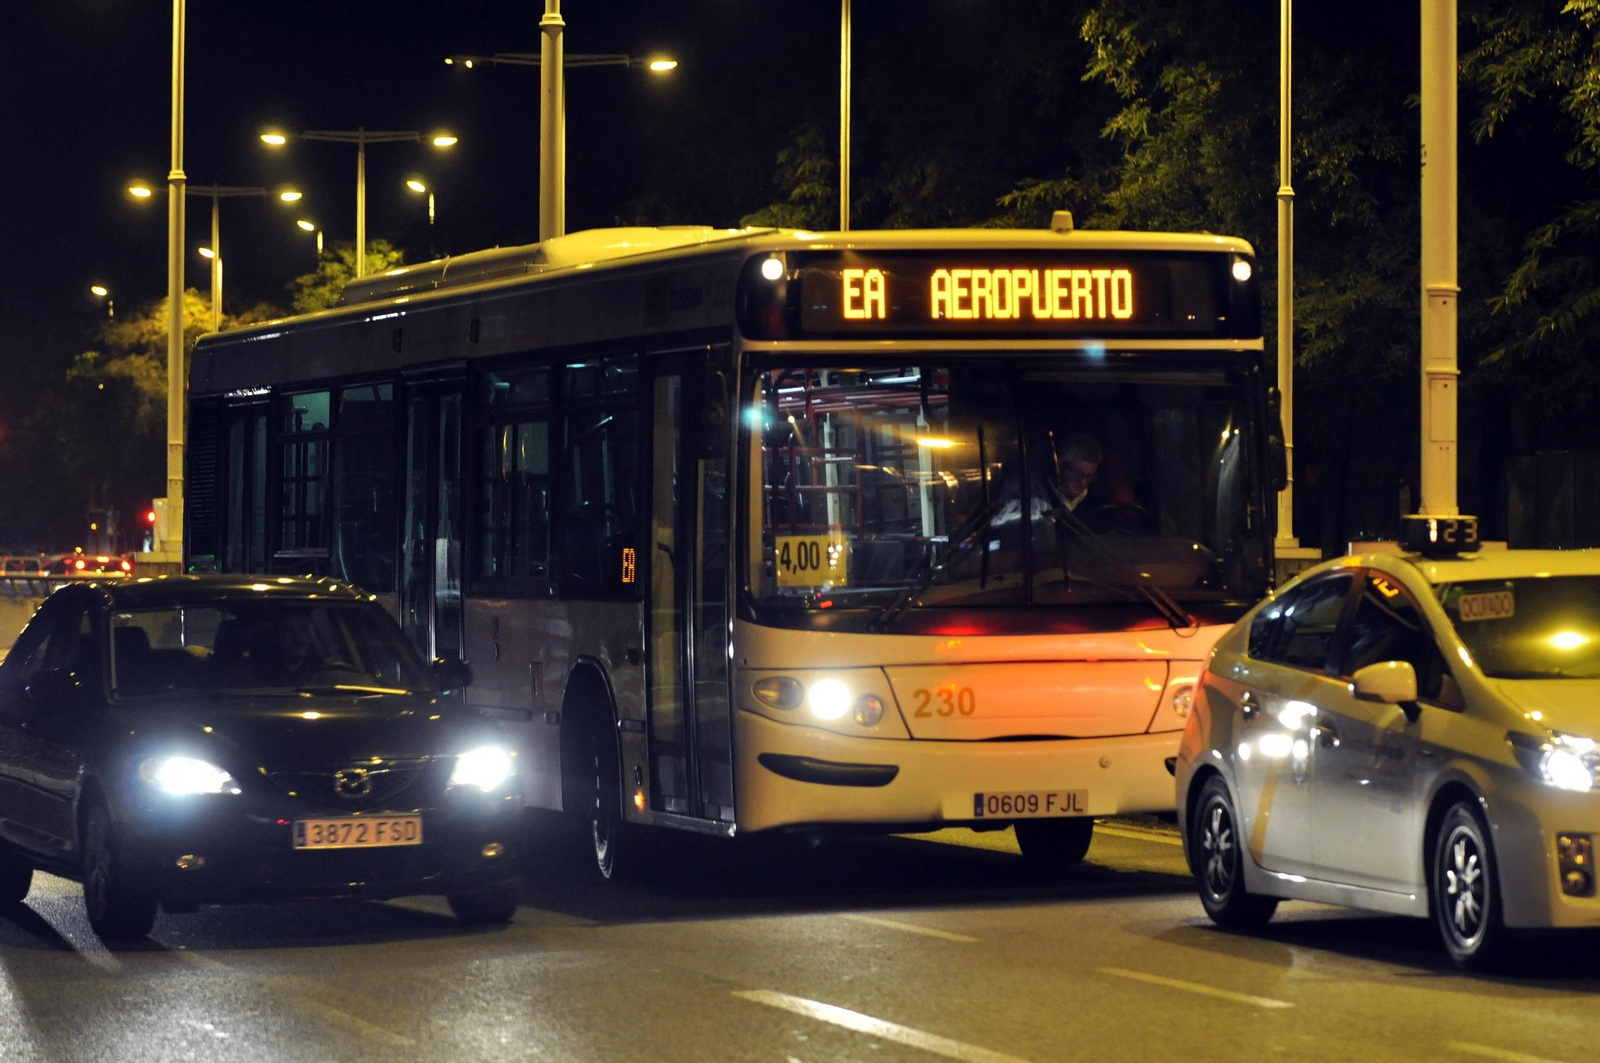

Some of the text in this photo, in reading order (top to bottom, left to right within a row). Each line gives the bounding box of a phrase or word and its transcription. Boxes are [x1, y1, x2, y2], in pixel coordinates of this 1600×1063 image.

[842, 268, 1135, 320] EA AEROPUERTO
[621, 548, 636, 583] EA
[780, 541, 820, 575] 4,00
[913, 687, 976, 718] 230
[988, 795, 1039, 814] 0609
[1046, 793, 1083, 812] FJL
[311, 820, 415, 844] 3872 FSD
